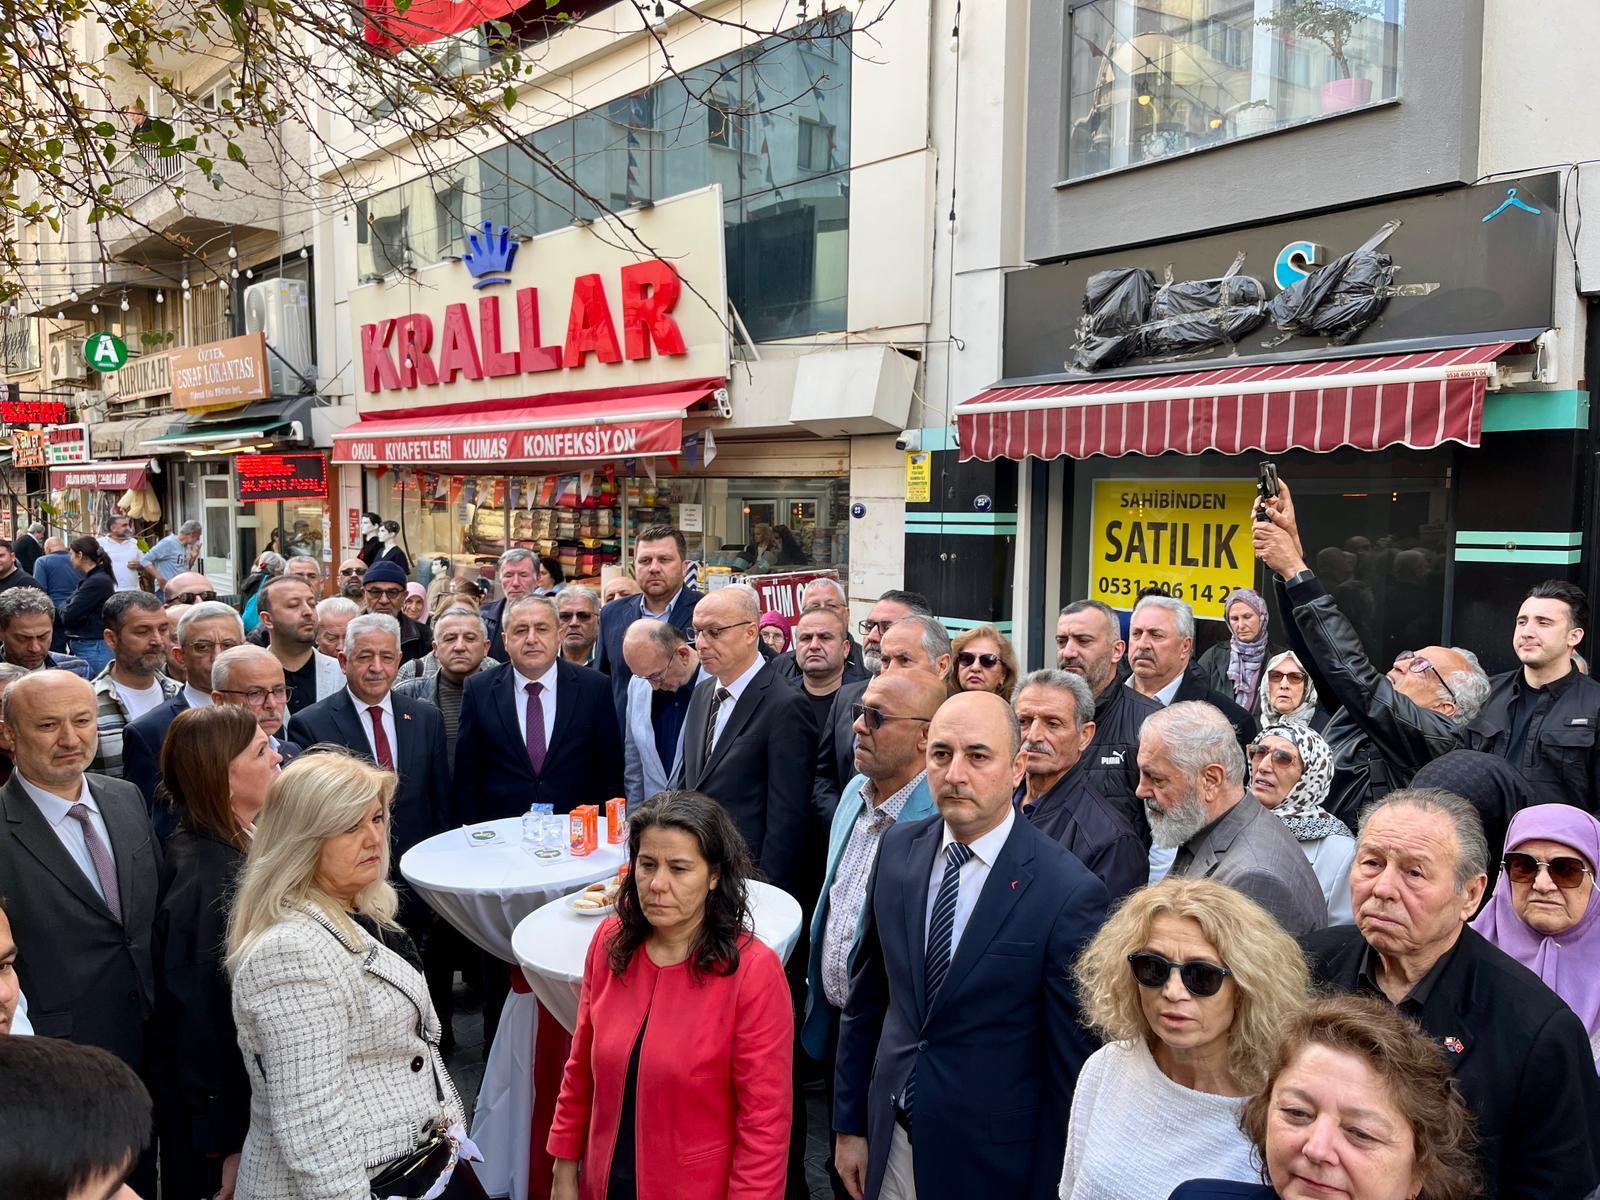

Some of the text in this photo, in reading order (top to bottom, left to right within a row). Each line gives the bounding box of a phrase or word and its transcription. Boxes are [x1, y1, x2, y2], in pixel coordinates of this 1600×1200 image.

[361, 259, 687, 393] KRALLAR
[94, 335, 119, 363] A
[177, 366, 202, 389] ESNAF
[351, 426, 637, 460] OKUL KIYAFETLERİ KUMAŞ KONFEKSİYON
[1120, 489, 1226, 510] SAHİBİNDEN
[1104, 520, 1240, 570] SATILIK
[762, 578, 795, 618] TÜM
[1098, 576, 1141, 596] 0531
[1190, 583, 1213, 602] 14
[1218, 585, 1242, 604] 2
